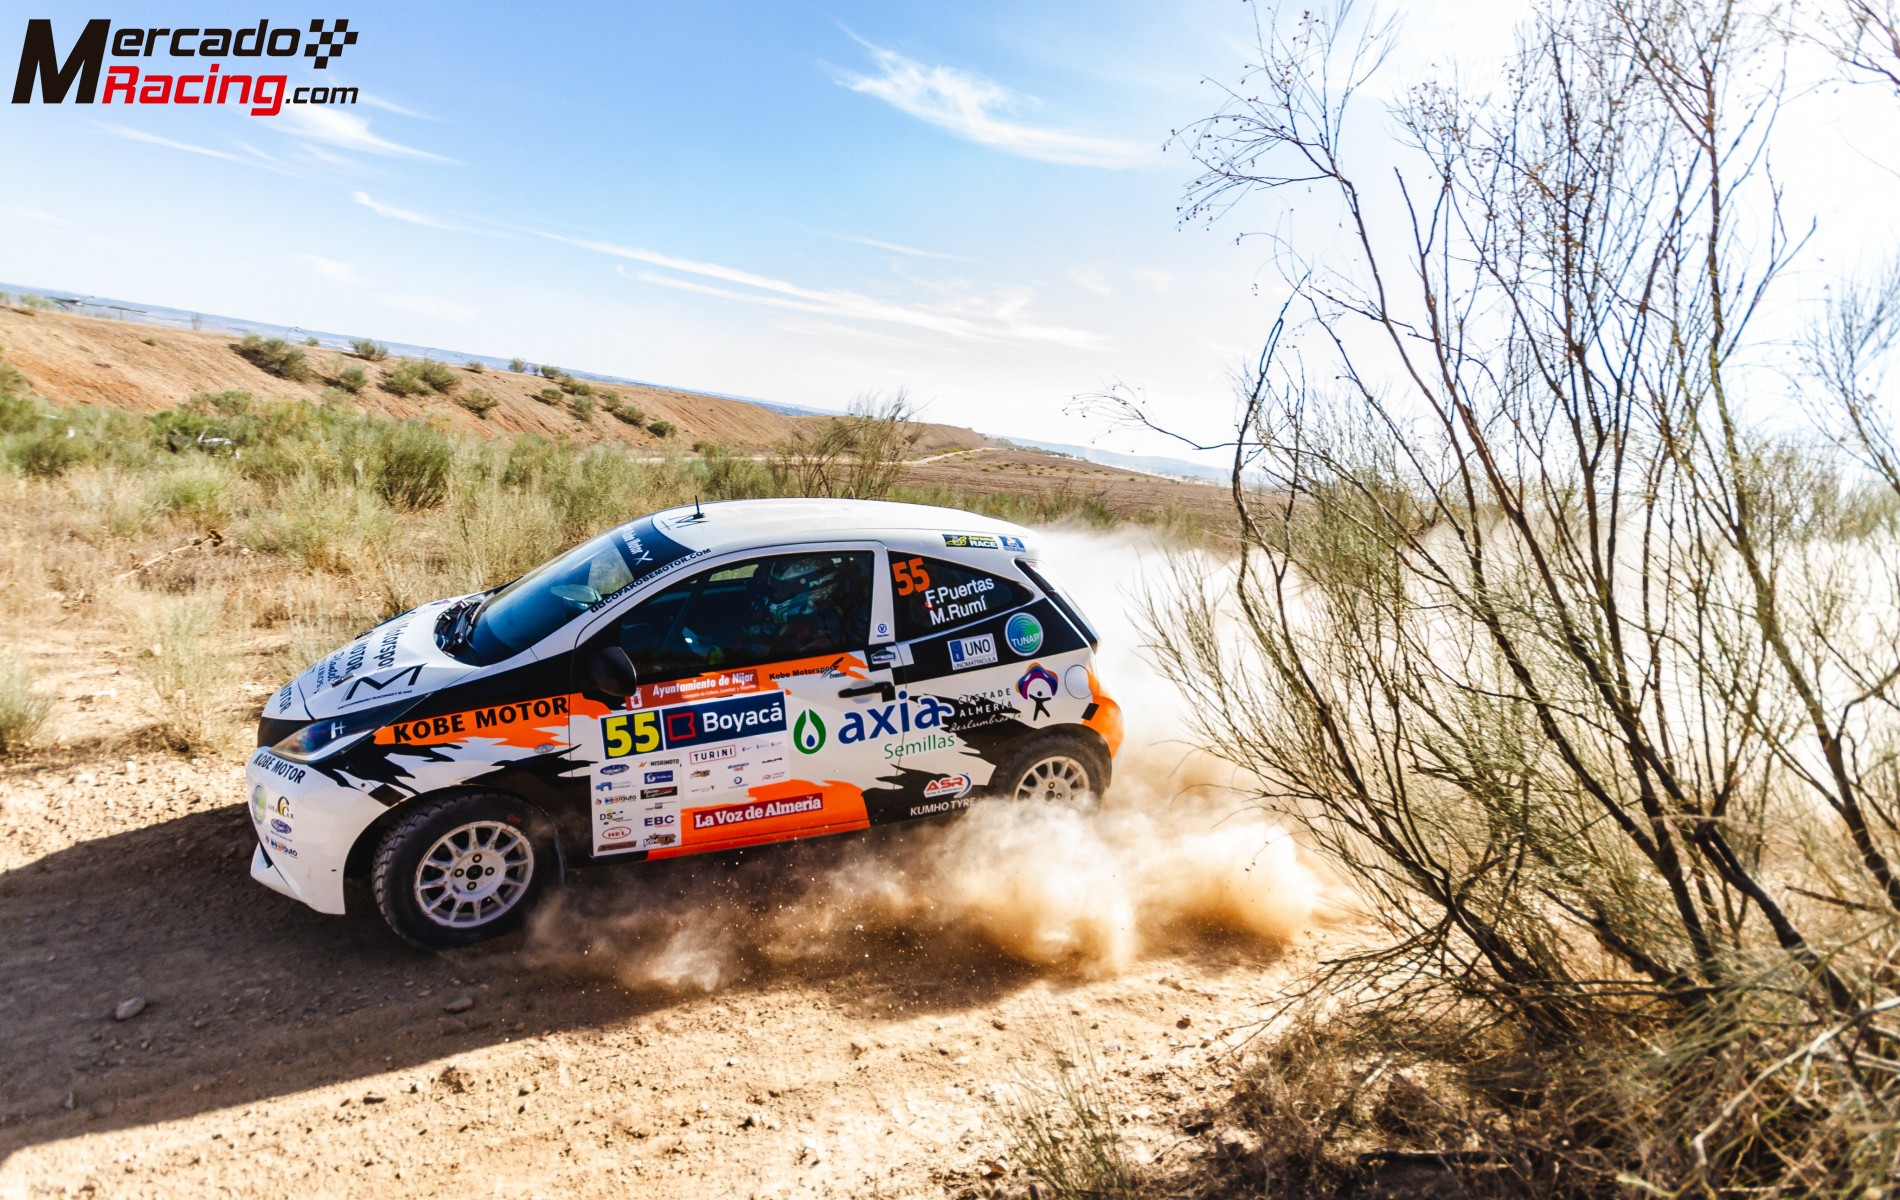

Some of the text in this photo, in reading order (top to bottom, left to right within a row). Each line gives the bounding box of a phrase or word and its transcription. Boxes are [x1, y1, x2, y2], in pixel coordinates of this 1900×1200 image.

[969, 540, 998, 548] RACE
[892, 557, 931, 596] 55
[924, 577, 995, 608] F.Puertas
[929, 595, 988, 627] M.Rumí
[964, 640, 991, 657] UNO
[1011, 632, 1042, 646] TUNAP
[953, 656, 996, 669] UNOMATRICULA
[652, 678, 717, 697] Ayuntamiento
[718, 674, 730, 687] de
[769, 671, 790, 681] Kobe
[393, 696, 570, 745] KOBE MOTOR
[838, 690, 954, 745] axia
[605, 711, 660, 758] 55
[694, 748, 733, 762] TURINI
[884, 734, 955, 760] Semillas
[253, 752, 306, 784] KOBE MOTOR
[650, 759, 680, 767] MISHIMOTO
[926, 776, 964, 792] ASR
[694, 795, 822, 829] La Voz de Almería
[910, 797, 976, 816] KUMHO TYRE
[599, 812, 613, 821] DS
[643, 814, 675, 827] EBC
